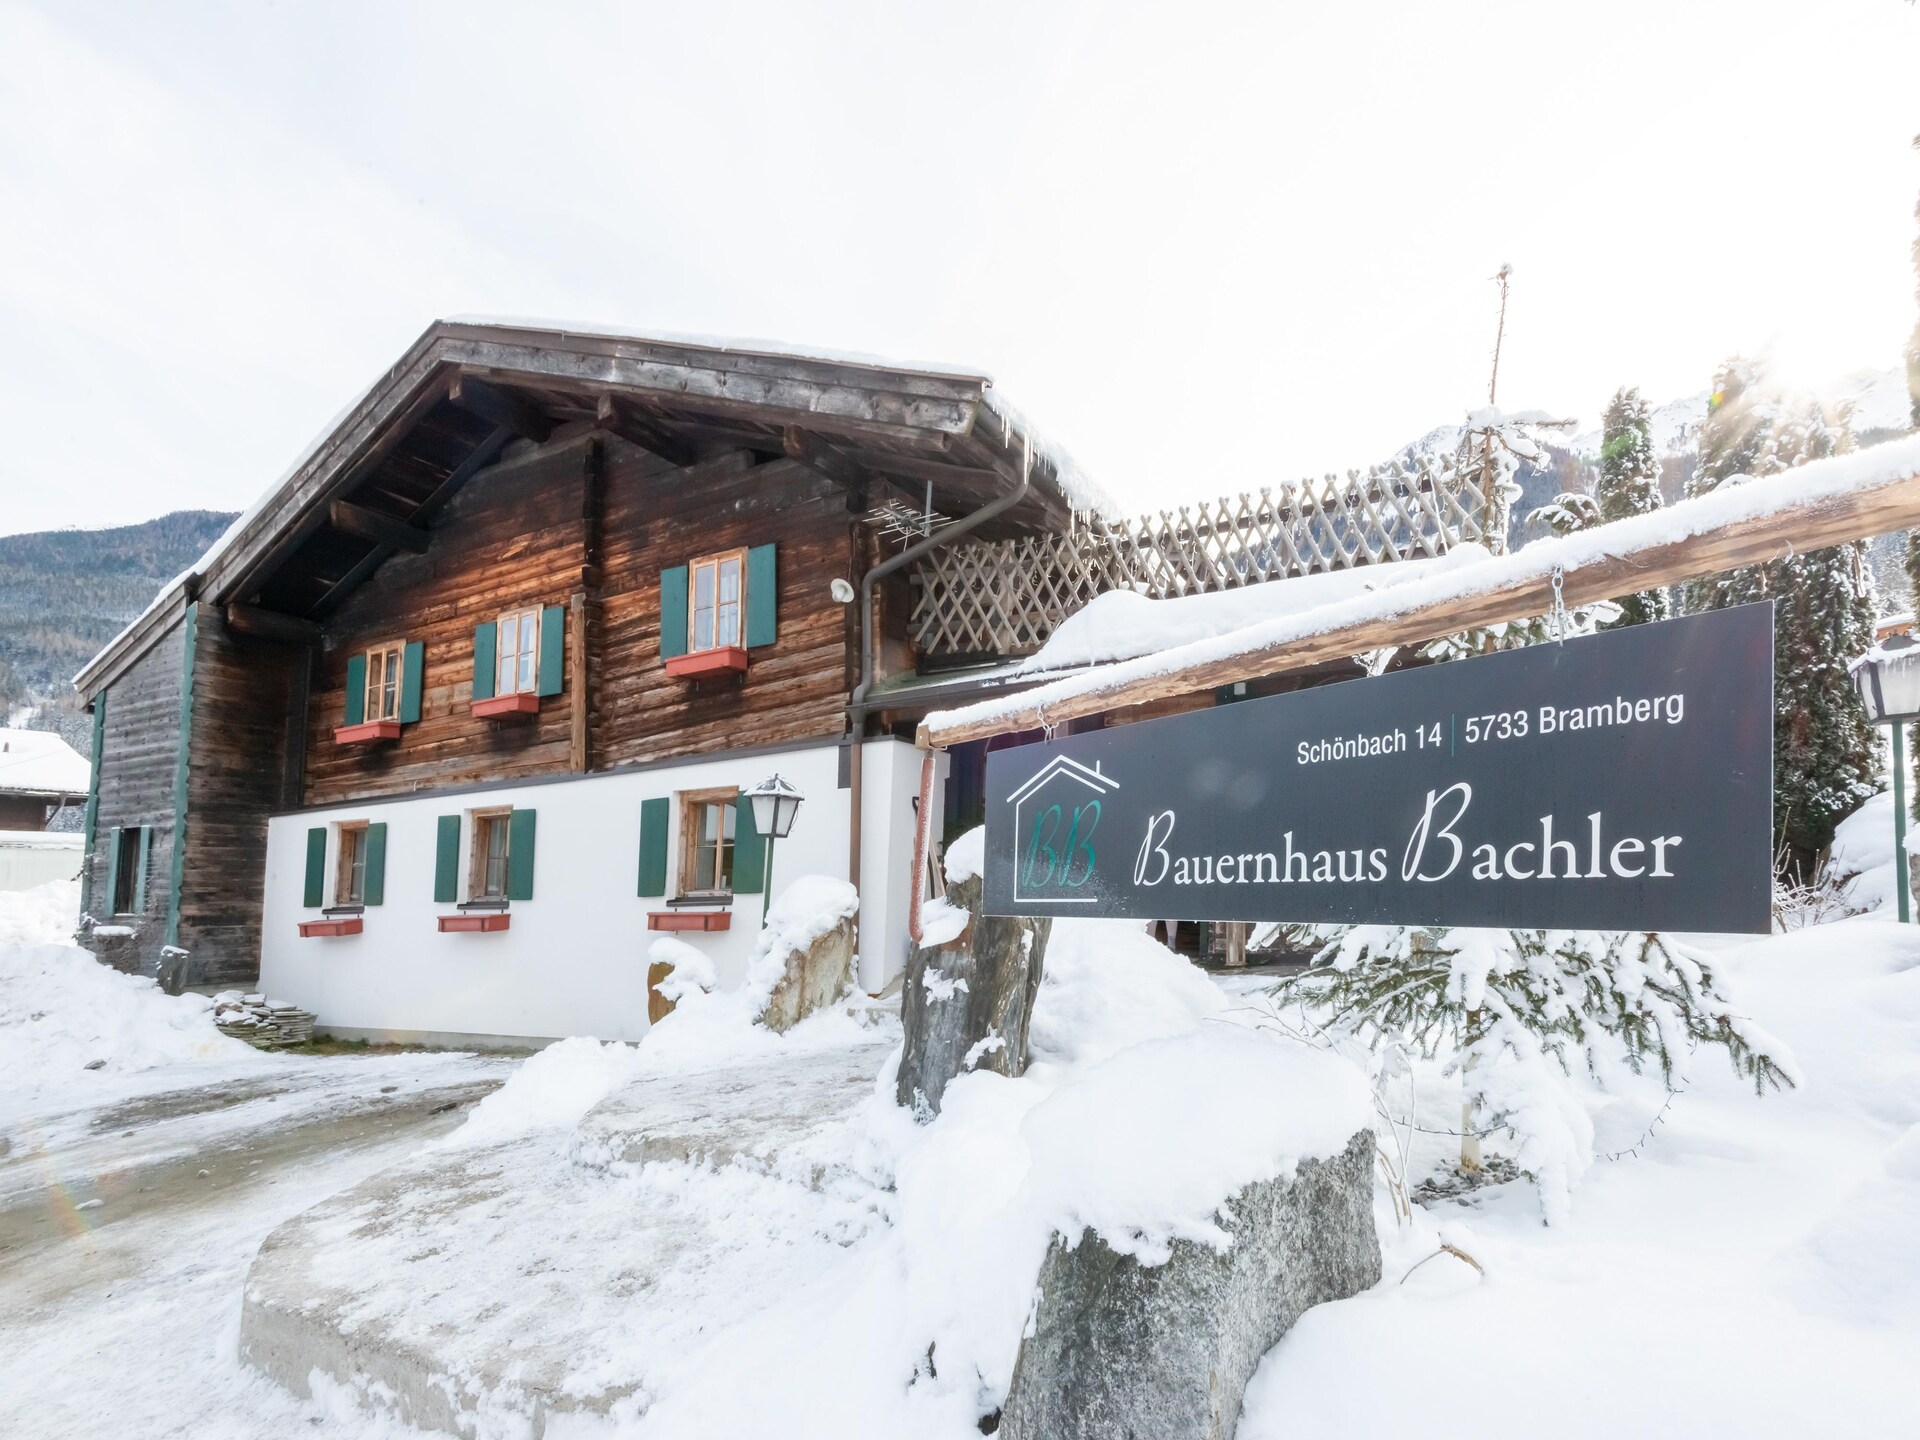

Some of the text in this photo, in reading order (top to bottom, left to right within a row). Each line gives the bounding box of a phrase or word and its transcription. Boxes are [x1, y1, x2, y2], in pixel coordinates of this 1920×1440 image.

[1296, 693, 1684, 765] Schönbach 14 5733 Bramberg
[1022, 799, 1102, 888] BB
[1133, 781, 1683, 887] Bauernhaus Bachler
